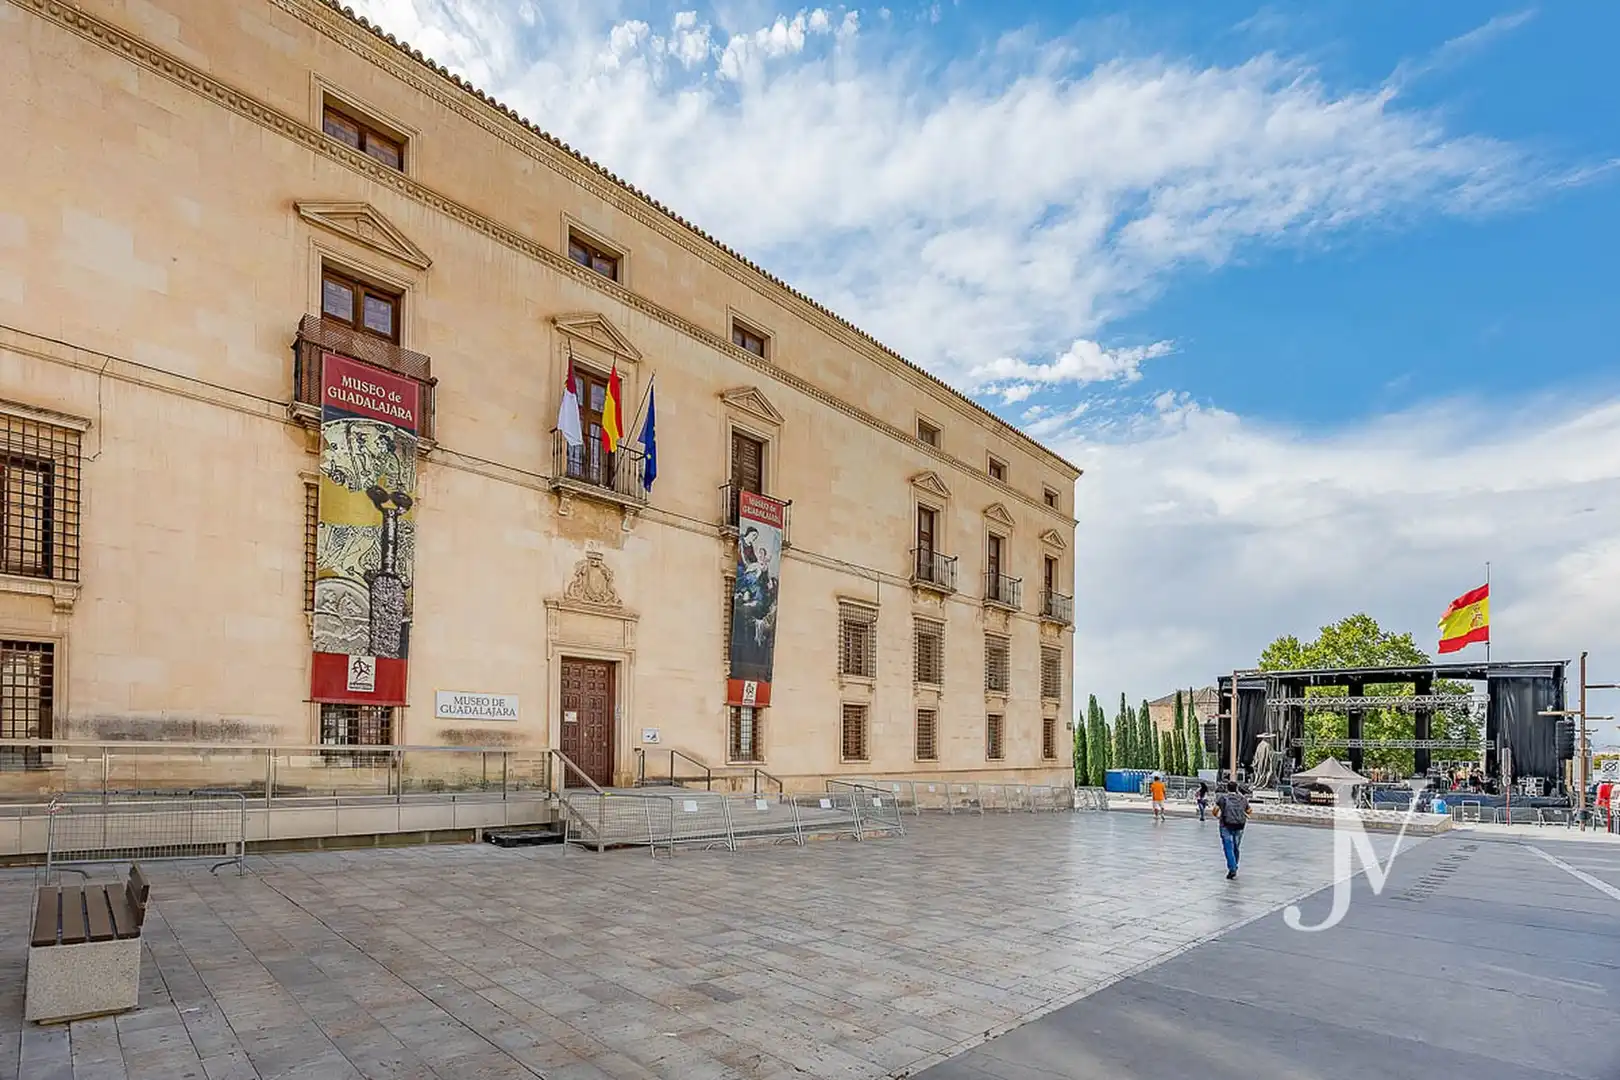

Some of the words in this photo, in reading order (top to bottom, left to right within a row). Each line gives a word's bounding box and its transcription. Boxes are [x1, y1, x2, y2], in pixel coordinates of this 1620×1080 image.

[341, 375, 385, 397] MUSEO
[388, 391, 402, 403] de
[327, 386, 412, 421] GUADALAJARA
[440, 704, 516, 717] GUADALAJARA
[453, 696, 490, 707] MUSEO
[491, 698, 505, 707] DE
